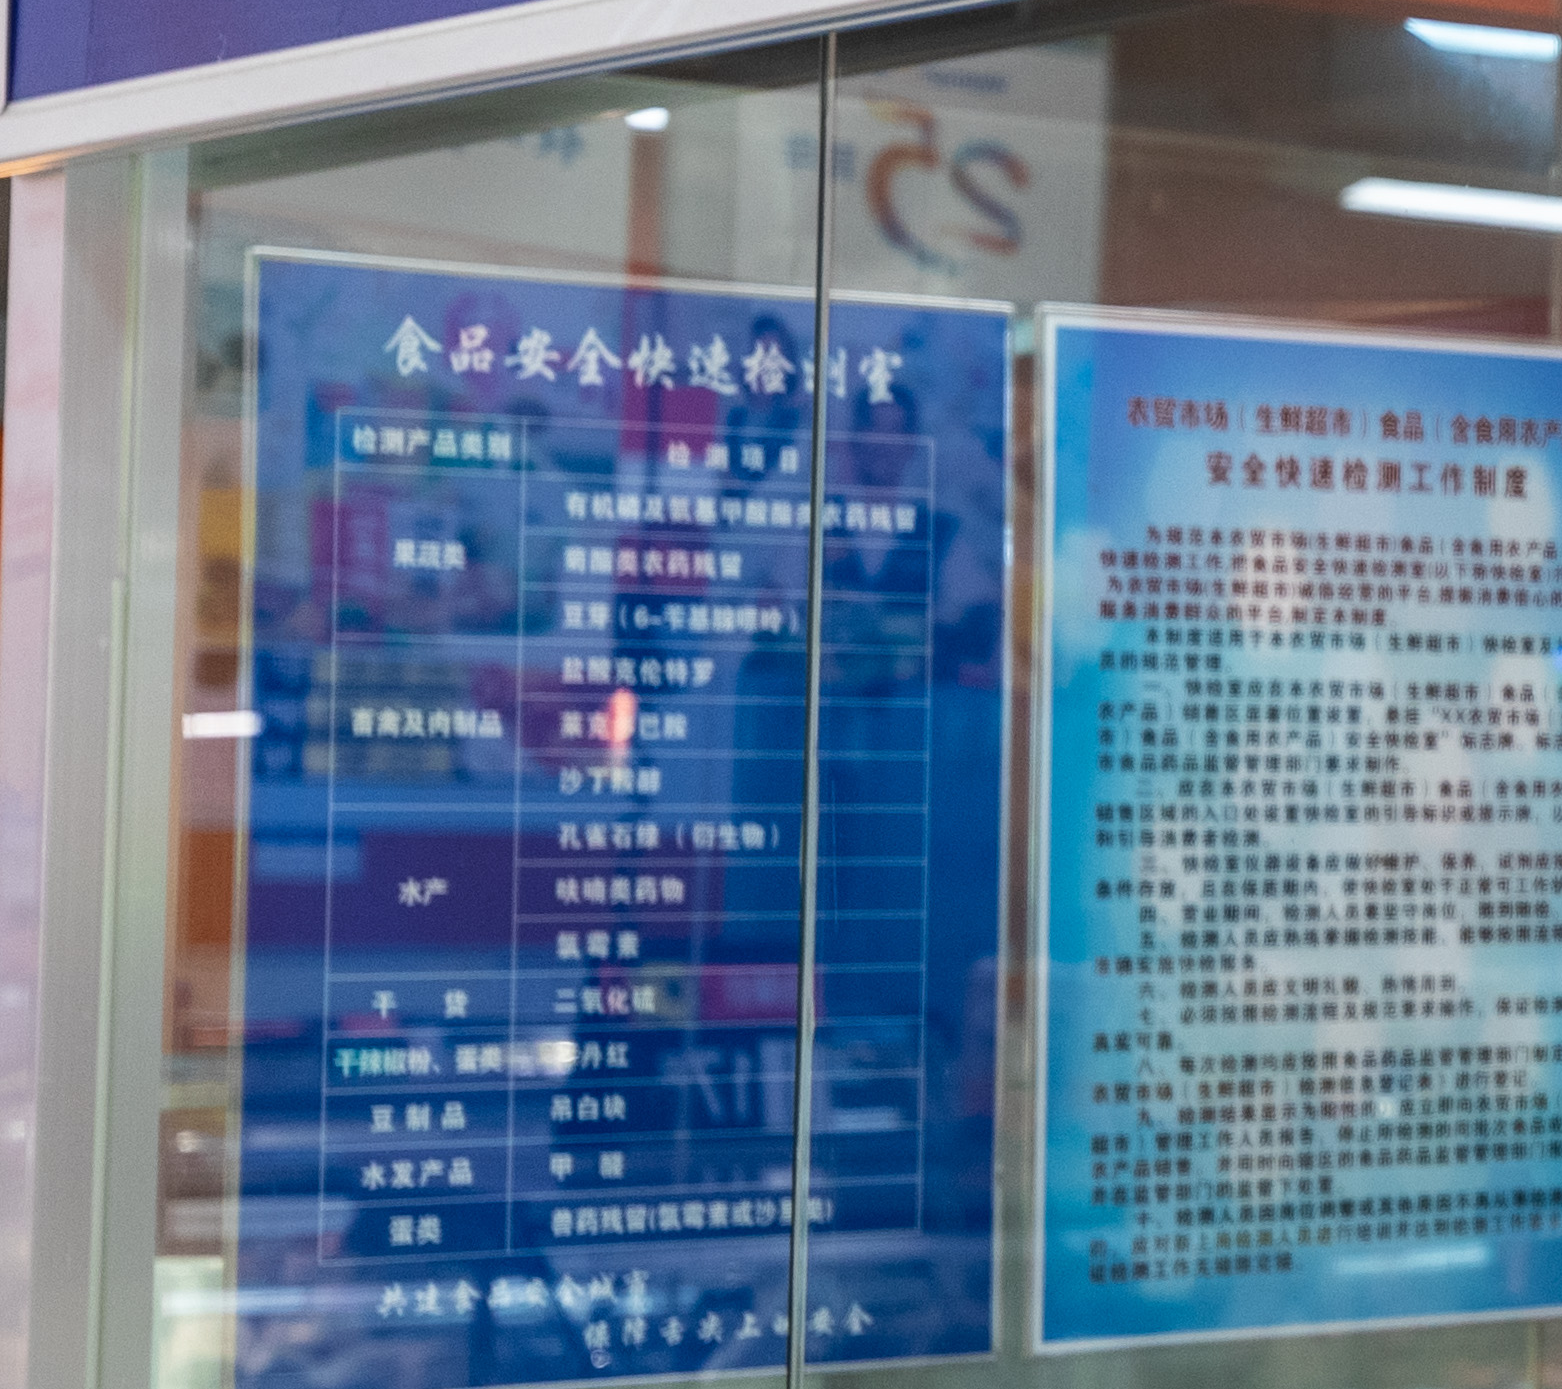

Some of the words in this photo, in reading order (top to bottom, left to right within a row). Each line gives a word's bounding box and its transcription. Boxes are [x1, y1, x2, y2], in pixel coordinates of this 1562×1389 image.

[383, 313, 905, 407] 食品安全快速检测室
[351, 425, 513, 463] 检测产品类别
[667, 439, 802, 474] 检测项目
[1205, 450, 1529, 500] 安全快速检测工作制度
[393, 538, 467, 573] 果蔬类
[398, 877, 449, 907] 水产
[553, 985, 657, 1015] 二氧化硫
[370, 1102, 467, 1133] 豆制品
[361, 1157, 475, 1190] 水发产品
[389, 1216, 442, 1246] 蛋类
